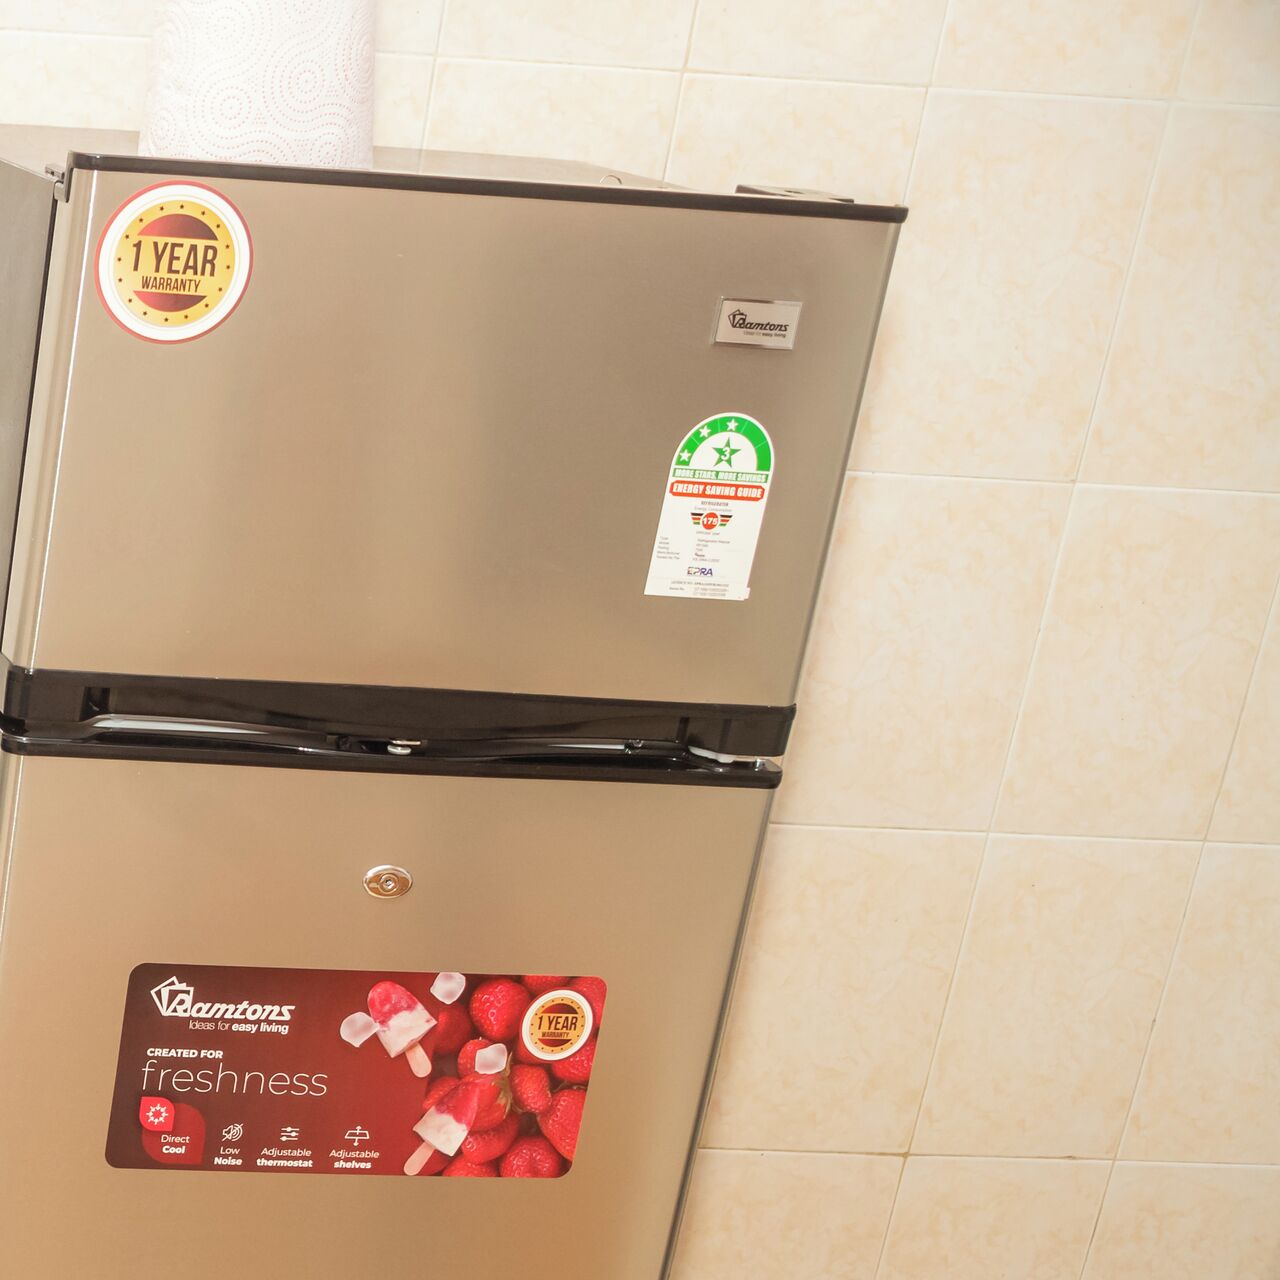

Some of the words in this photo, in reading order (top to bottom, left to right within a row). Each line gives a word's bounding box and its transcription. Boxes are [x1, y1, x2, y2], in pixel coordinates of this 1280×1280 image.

[132, 240, 142, 272] 1
[153, 241, 218, 277] YEAR
[141, 275, 202, 293] WARRANTY
[731, 313, 789, 331] Ramtons
[721, 447, 731, 460] 3
[674, 468, 694, 478] MORE
[718, 471, 737, 481] MORE
[737, 472, 767, 482] SAVINGS
[673, 483, 705, 494] ENERGY
[705, 485, 736, 496] SAVING
[737, 487, 763, 498] GUIDE
[703, 517, 718, 526] 175
[687, 566, 713, 576] EPRA
[158, 985, 296, 1021] Ramtons
[189, 1020, 215, 1031] Ideas
[217, 1020, 231, 1031] for
[231, 1023, 259, 1034] easy
[260, 1022, 289, 1035] living
[538, 1015, 544, 1030] 1
[547, 1016, 578, 1031] YEAR
[147, 1048, 198, 1058] CREATED
[200, 1050, 223, 1059] FOR
[141, 1059, 328, 1097] freshness
[161, 1134, 190, 1144] Direct
[162, 1144, 186, 1154] Cool
[220, 1146, 240, 1155] Low
[261, 1147, 312, 1158] Adjustable
[329, 1148, 380, 1160] Adjustable
[213, 1156, 243, 1166] Noise
[256, 1157, 313, 1168] thermostat
[333, 1159, 372, 1169] shelves
